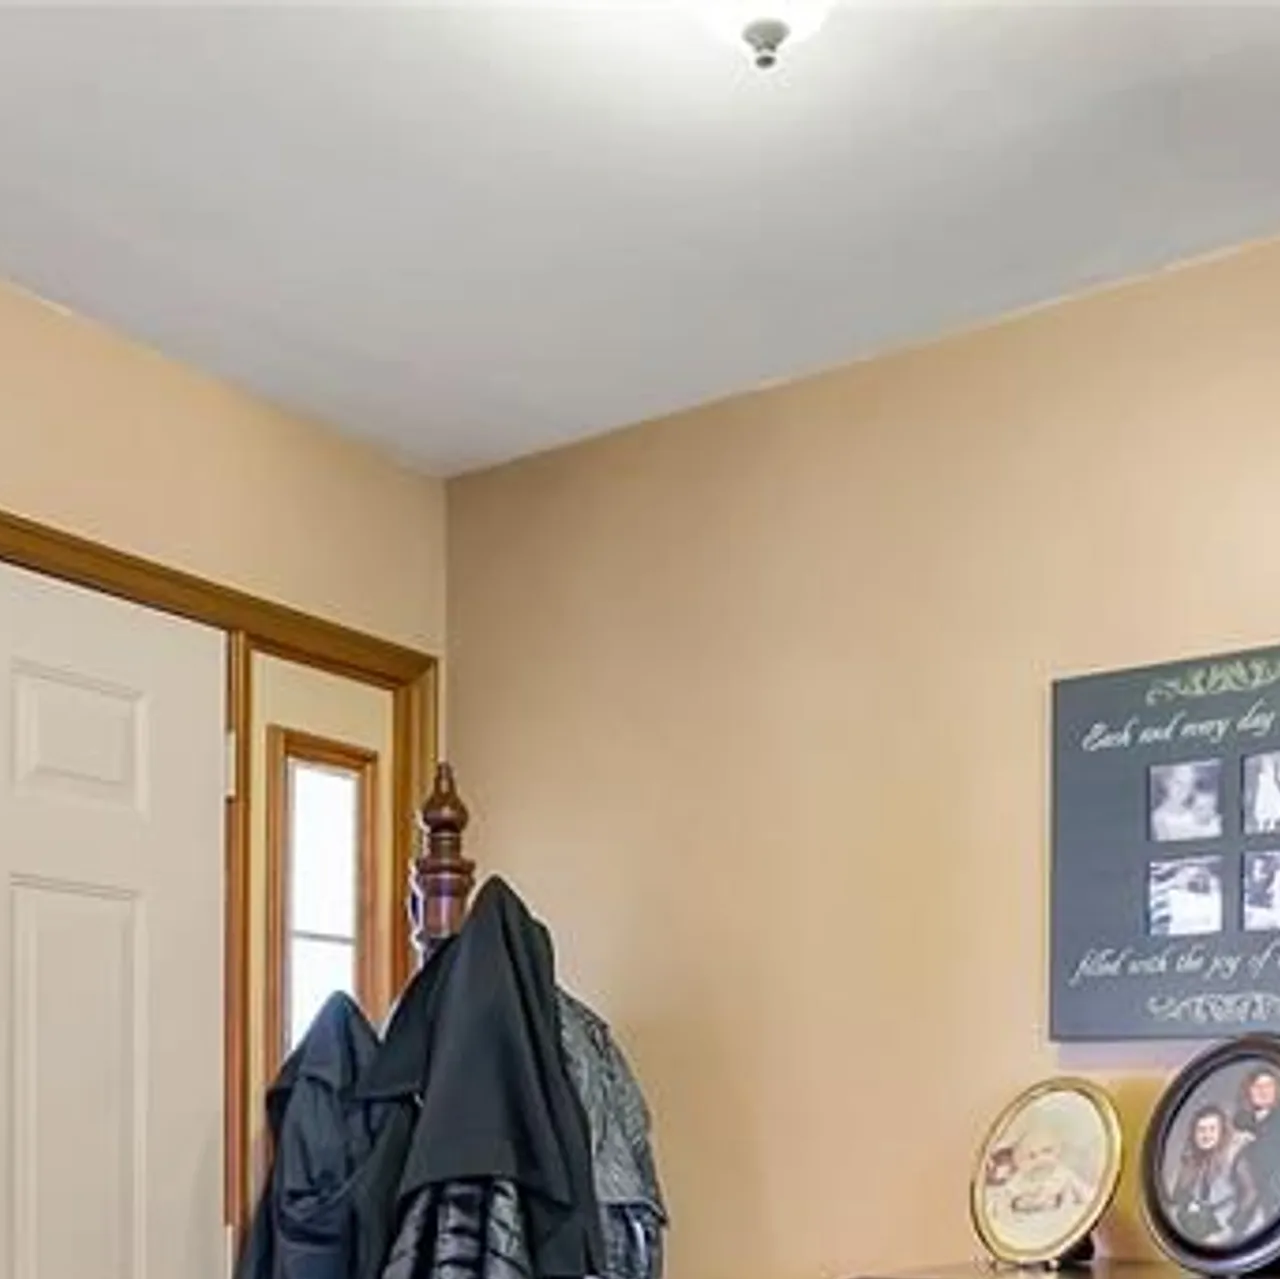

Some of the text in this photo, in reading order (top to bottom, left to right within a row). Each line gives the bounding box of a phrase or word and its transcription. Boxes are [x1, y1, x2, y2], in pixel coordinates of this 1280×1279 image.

[1081, 715, 1133, 752] Each
[1139, 711, 1179, 744] and
[1181, 716, 1231, 743] every
[1238, 700, 1277, 738] day
[1069, 947, 1126, 986] filled
[1128, 946, 1169, 975] with
[1176, 943, 1207, 972] the
[1206, 949, 1241, 980] joy
[1249, 939, 1280, 979] of
